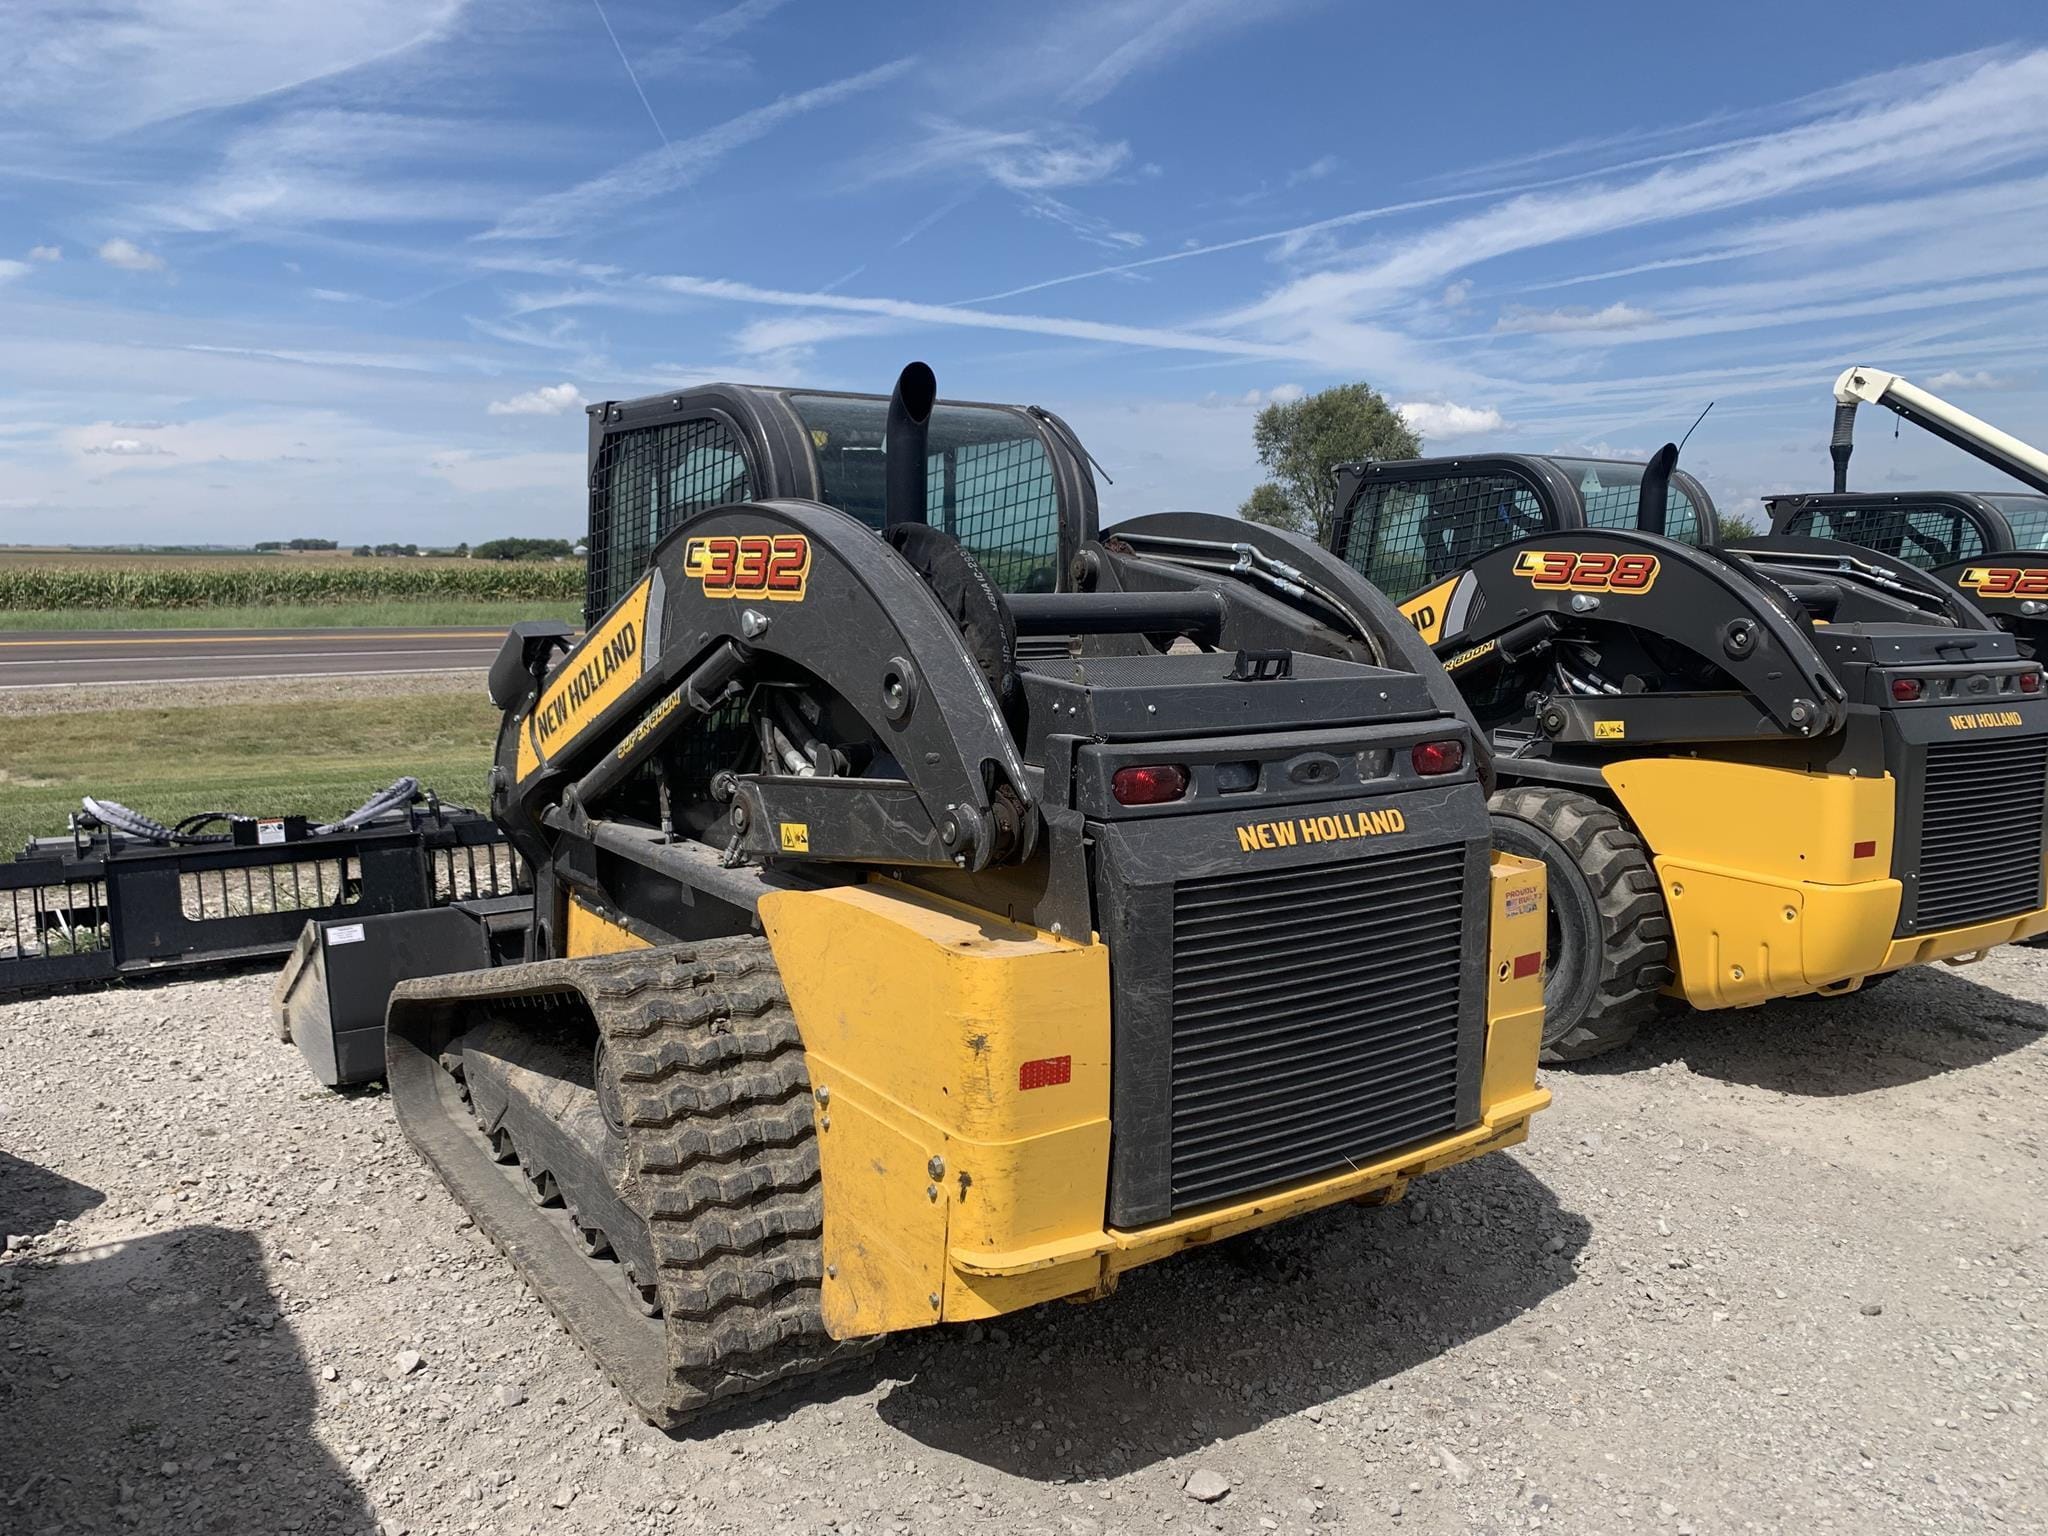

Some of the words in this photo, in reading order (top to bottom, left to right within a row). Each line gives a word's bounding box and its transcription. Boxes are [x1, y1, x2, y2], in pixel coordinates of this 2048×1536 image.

[685, 535, 811, 600] C332
[1513, 551, 1661, 594] L328
[1959, 568, 2048, 599] L32
[537, 690, 568, 743] NEW
[568, 622, 636, 712] HOLLAND
[1949, 714, 1977, 730] NEW
[1976, 711, 2023, 728] HOLLAND
[1236, 820, 1298, 852] NEW
[1299, 808, 1406, 844] HOLLAND
